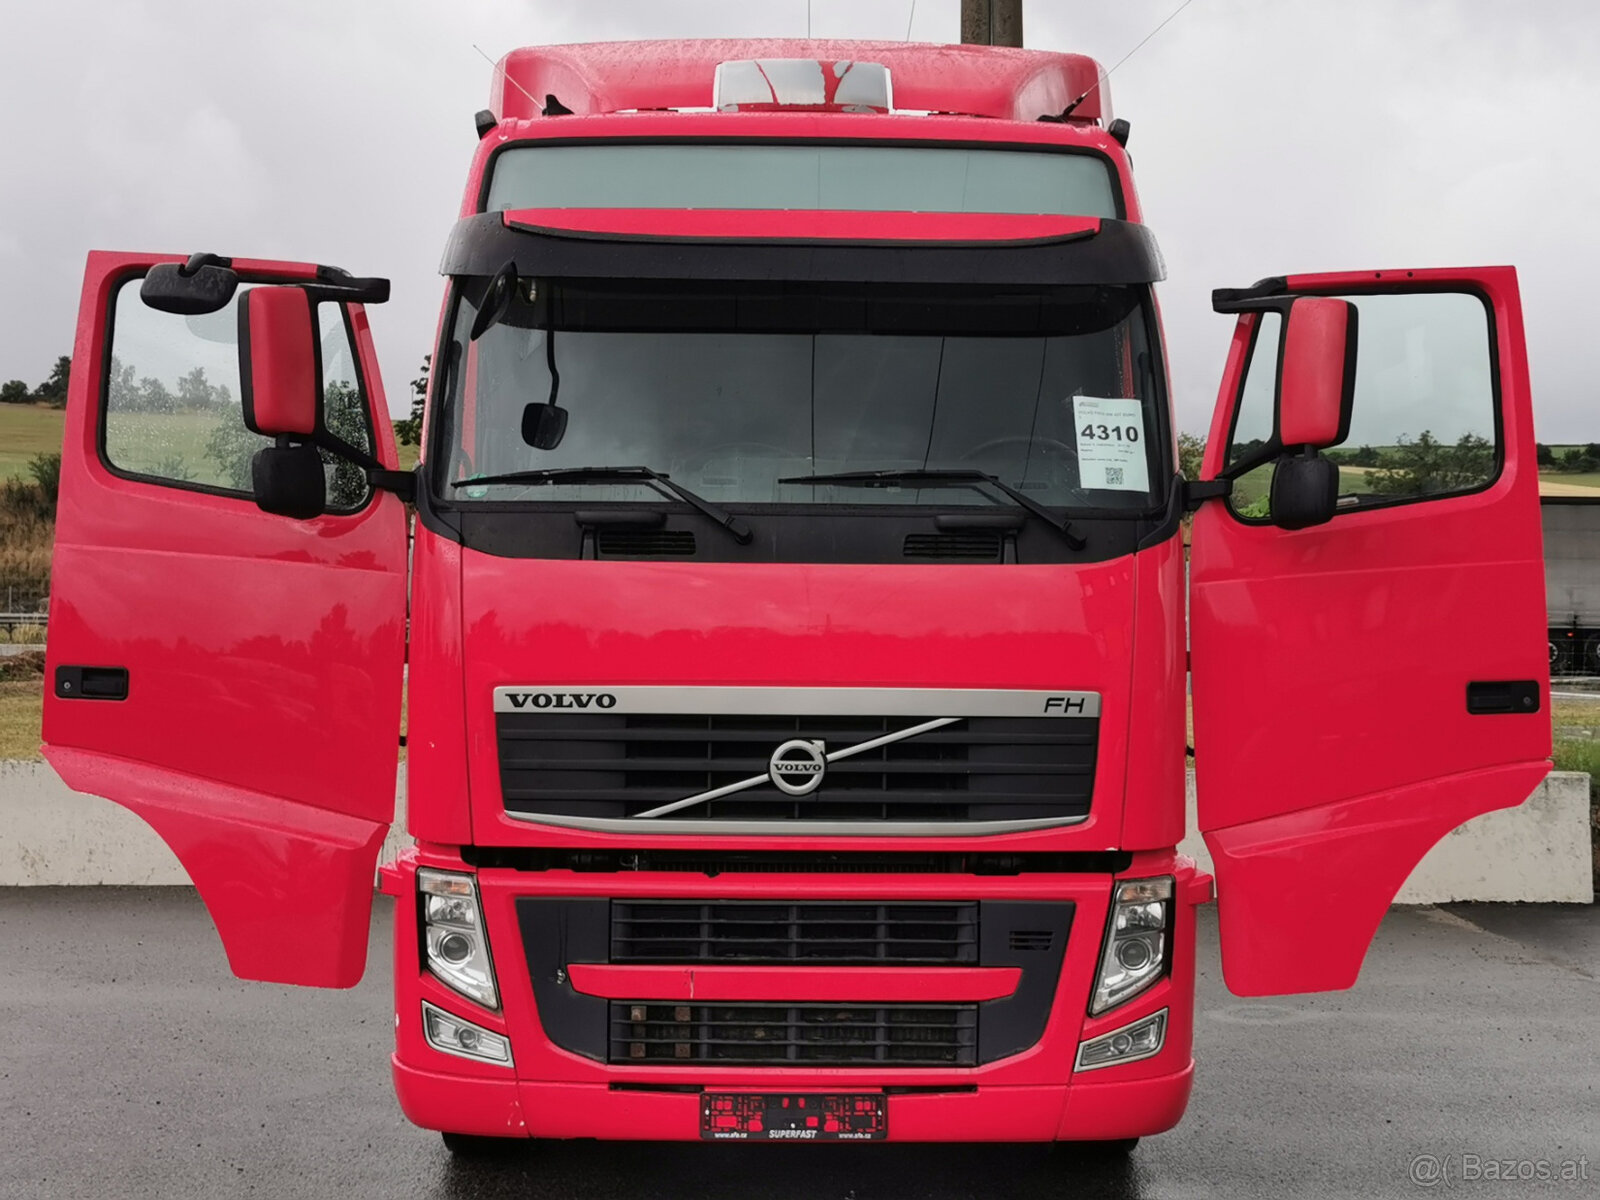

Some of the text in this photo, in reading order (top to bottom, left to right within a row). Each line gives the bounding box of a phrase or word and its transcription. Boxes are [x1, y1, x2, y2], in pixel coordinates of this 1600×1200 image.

[1081, 424, 1139, 442] 4310
[504, 693, 617, 709] VOLVO
[1043, 697, 1085, 714] FH
[773, 763, 822, 772] VOLVO
[768, 1129, 818, 1139] SUPERFAST
